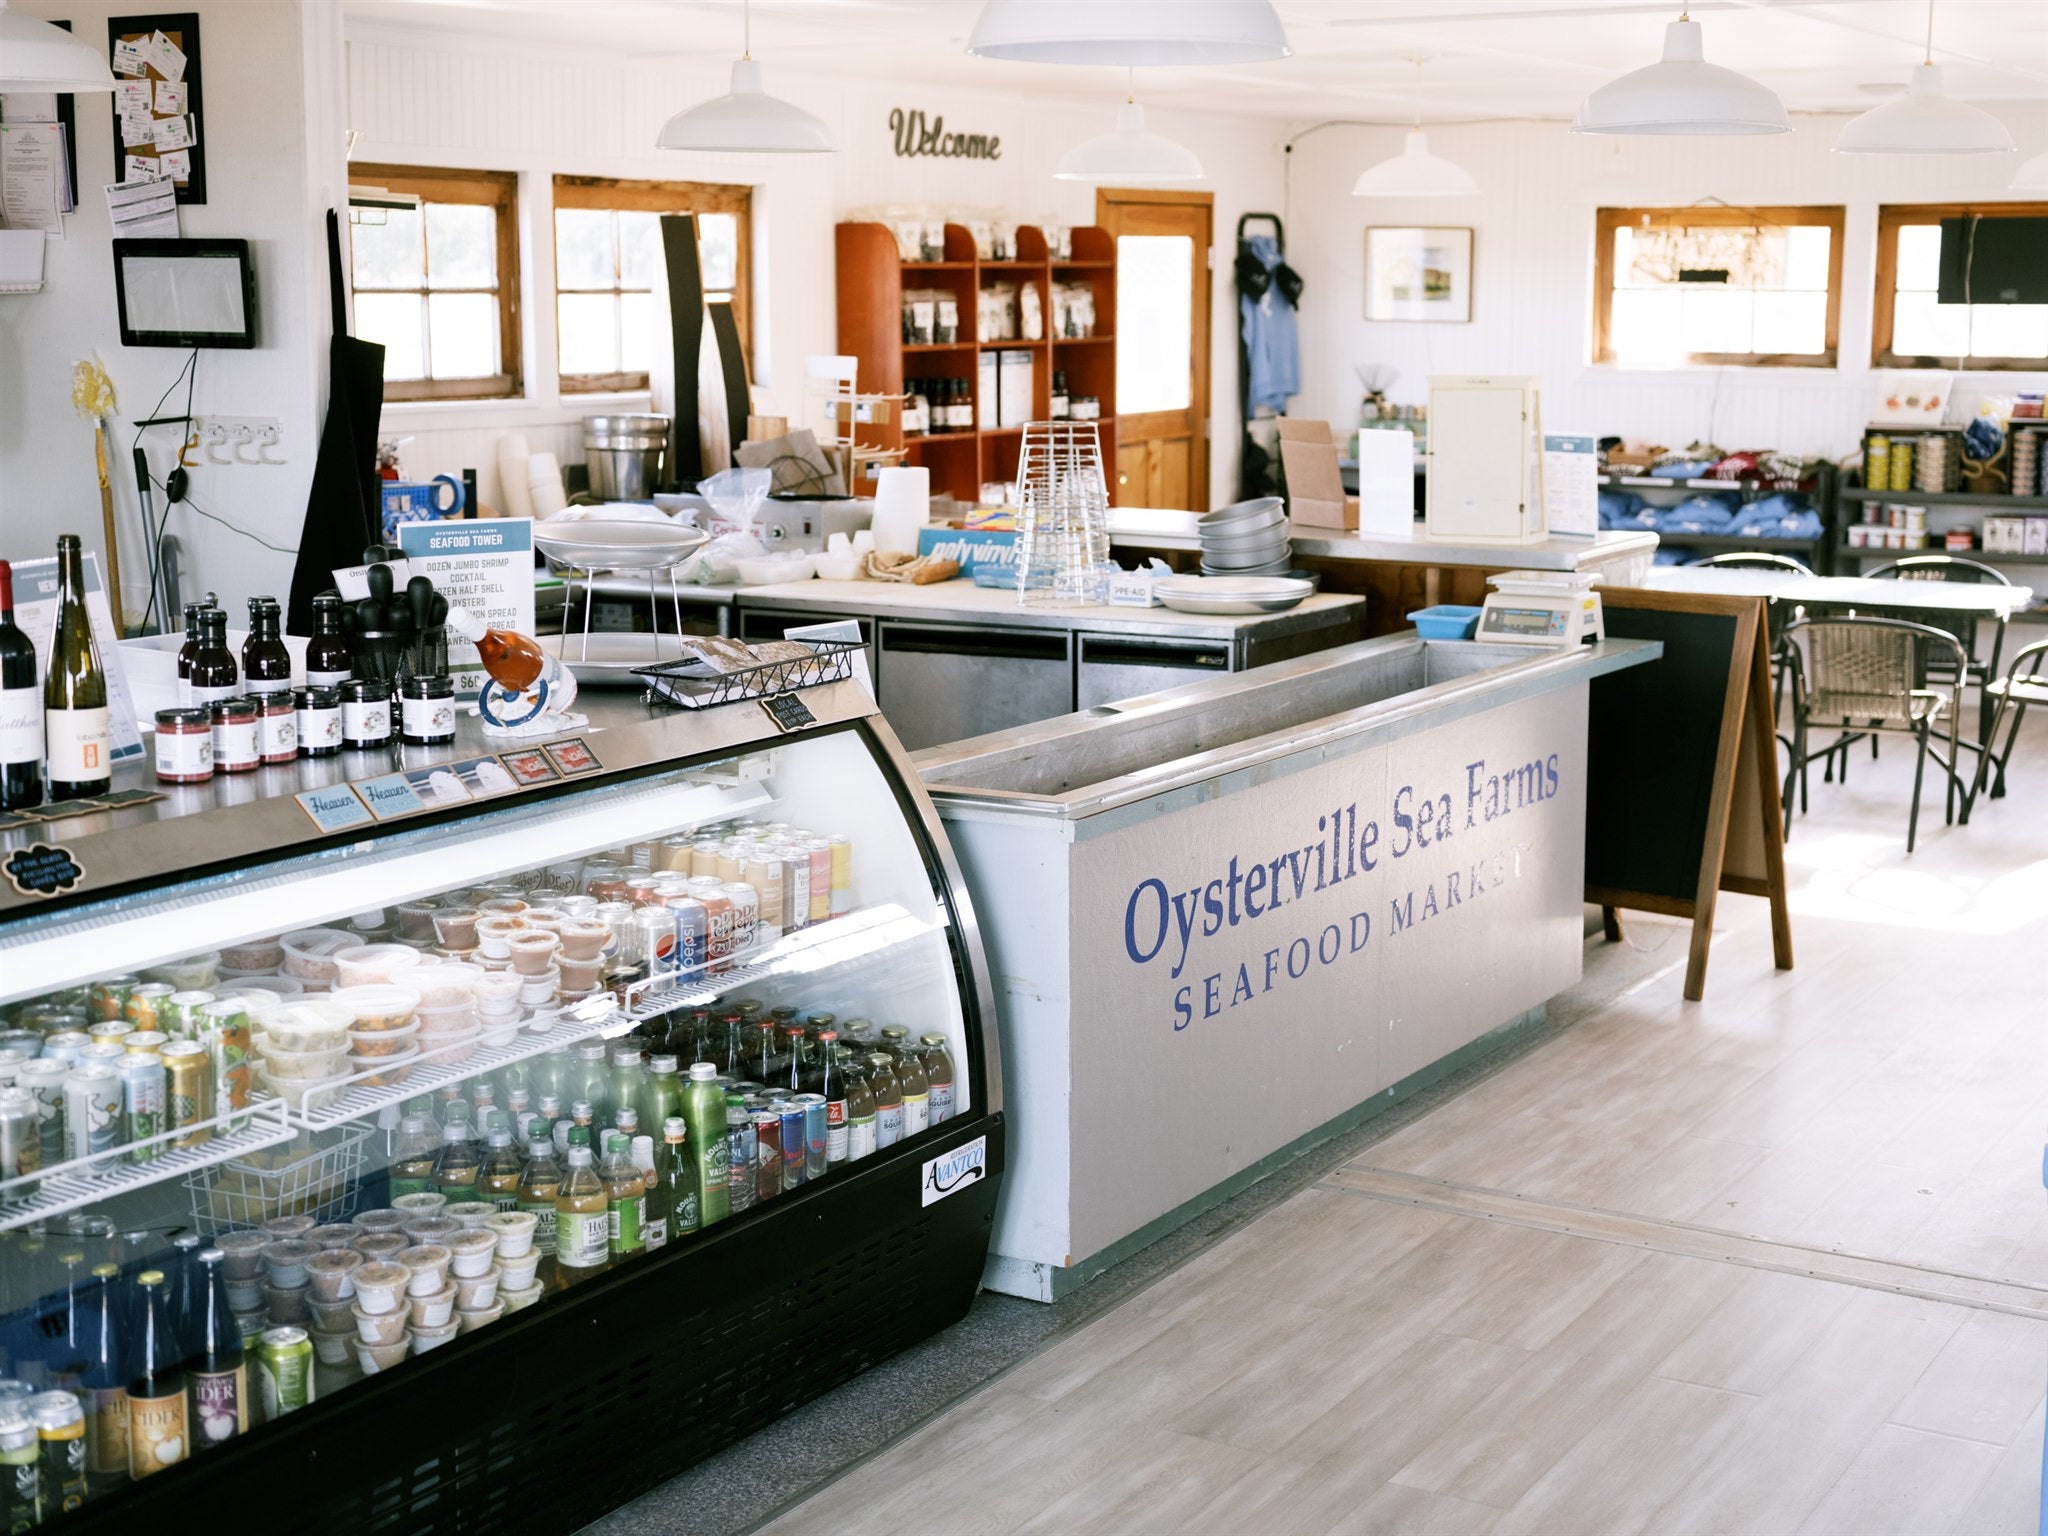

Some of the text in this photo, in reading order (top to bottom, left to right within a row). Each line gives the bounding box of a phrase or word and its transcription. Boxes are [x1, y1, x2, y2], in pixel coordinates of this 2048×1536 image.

[889, 107, 1002, 160] Welcome
[430, 534, 503, 549] SEAFOOD TOWER
[426, 558, 509, 572] DOZEN JUMBO SHRIMP
[449, 572, 487, 583] COCKTAIL
[458, 585, 479, 595] HALF
[481, 583, 504, 594] SHELL
[452, 597, 486, 608] OYSTERS
[487, 607, 517, 618] SPREAD
[365, 785, 409, 802] Heaven
[309, 795, 355, 813] Heaven
[1124, 752, 1559, 979] Oysterville Sea Farms
[1173, 911, 1372, 1033] SEAFOOD
[708, 1166, 729, 1177] VALL
[925, 1147, 984, 1192] AVANTCO
[679, 1217, 698, 1227] VALL
[196, 1386, 235, 1400] IDER
